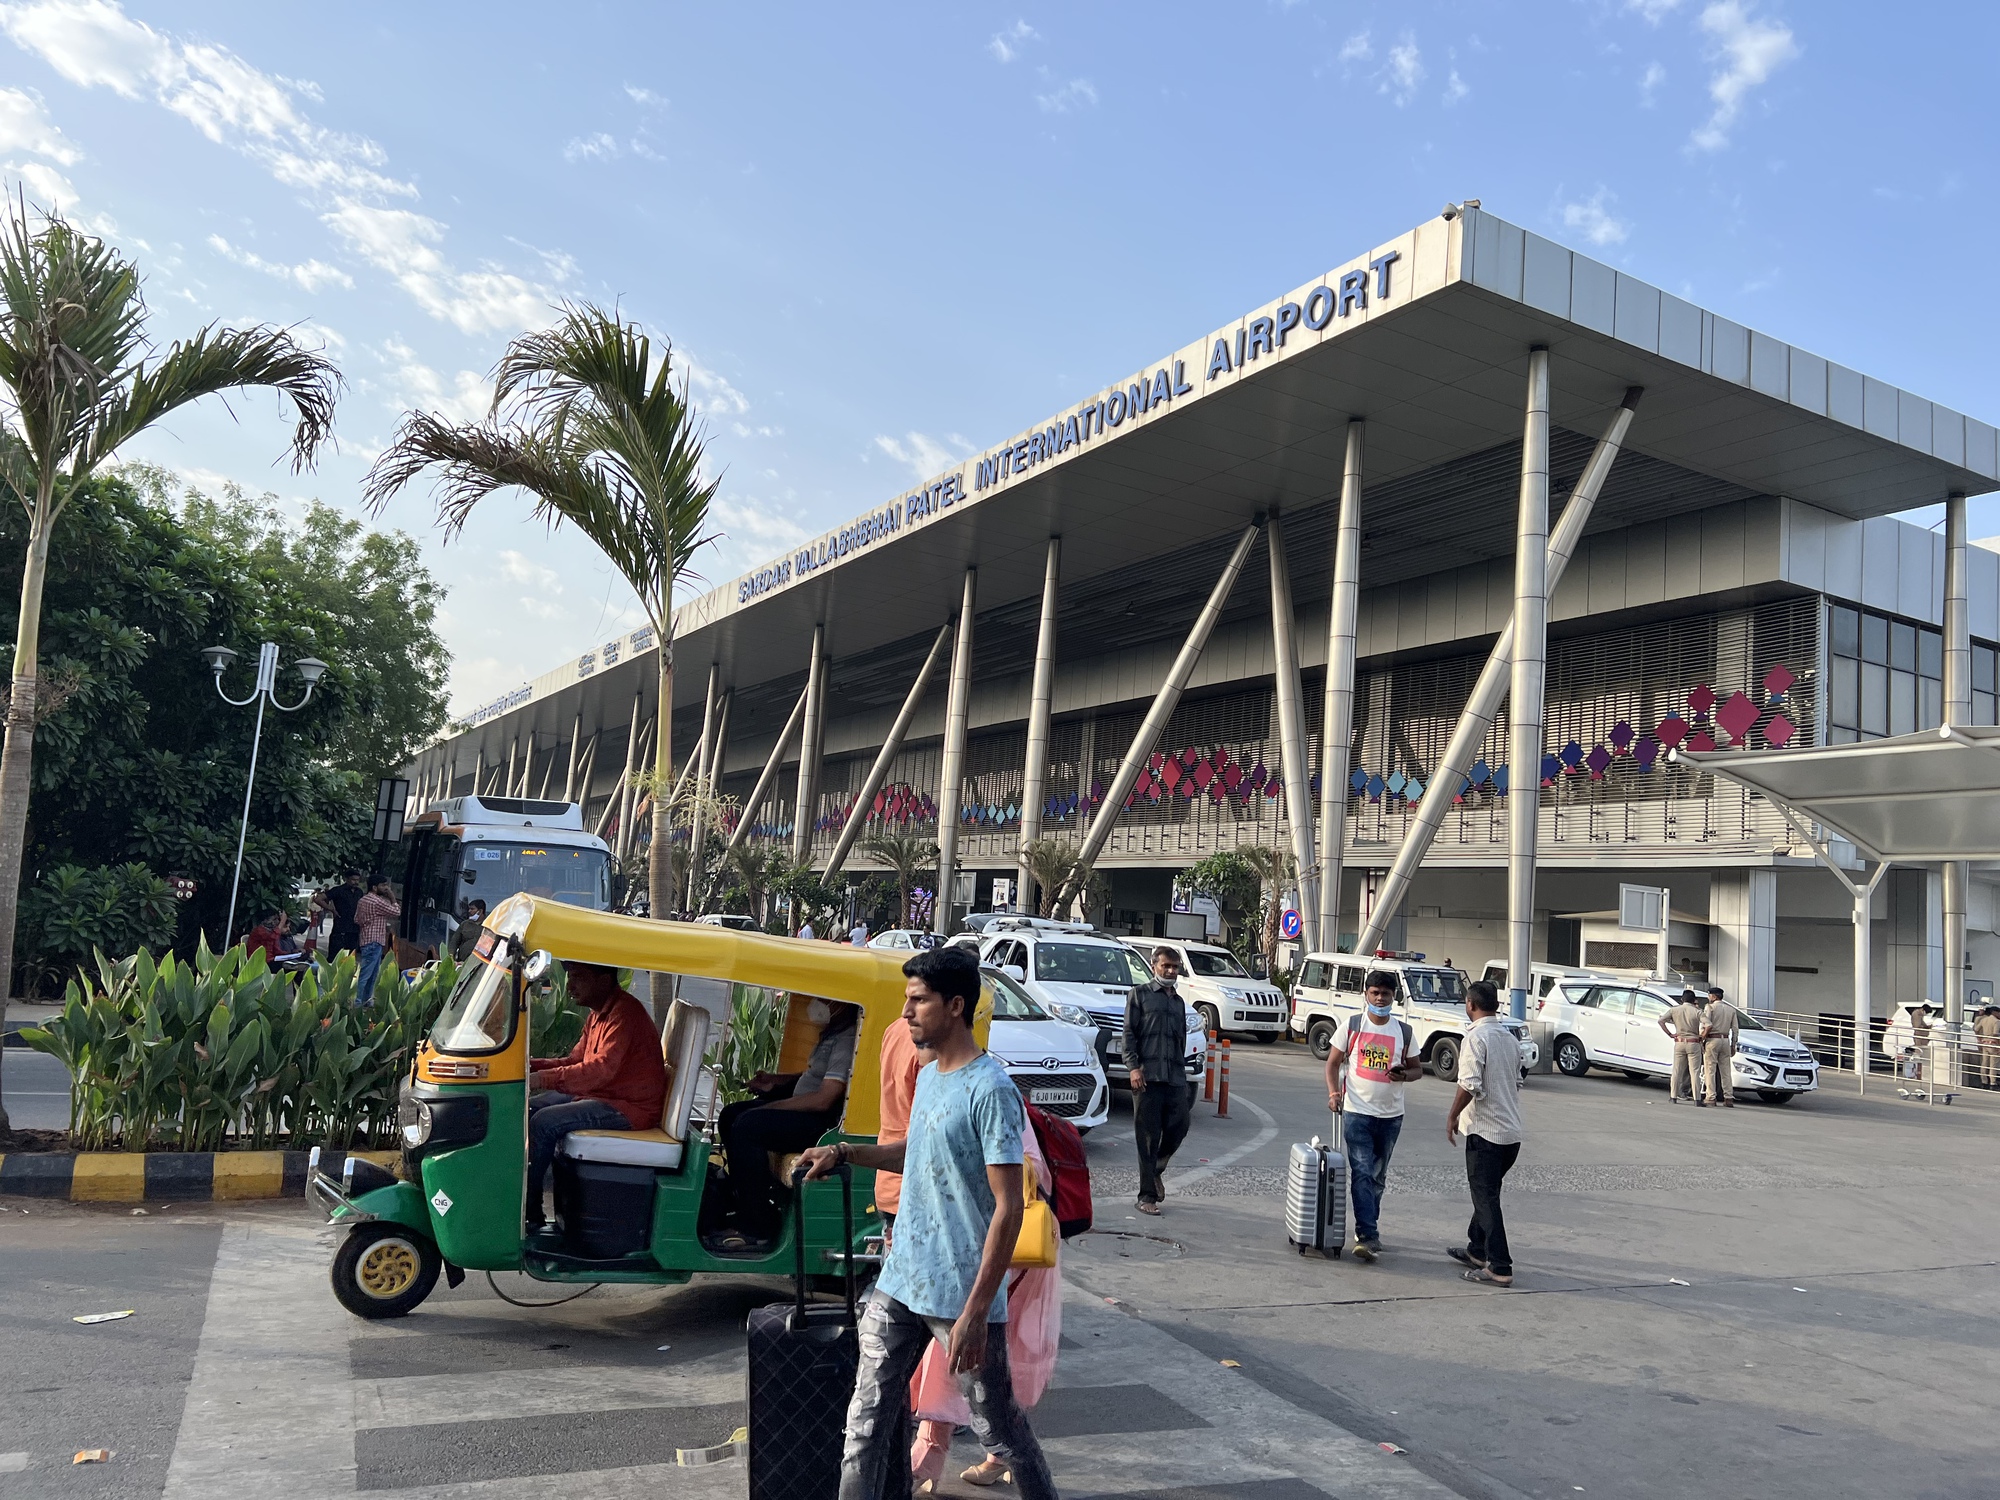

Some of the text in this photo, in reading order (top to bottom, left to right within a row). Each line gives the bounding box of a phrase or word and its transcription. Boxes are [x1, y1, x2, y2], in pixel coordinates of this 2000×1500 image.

[738, 250, 1400, 603] SARDAR VALLABHBHAI PATEL INTERNATIONAL AIRPORT
[434, 1198, 447, 1206] CNG
